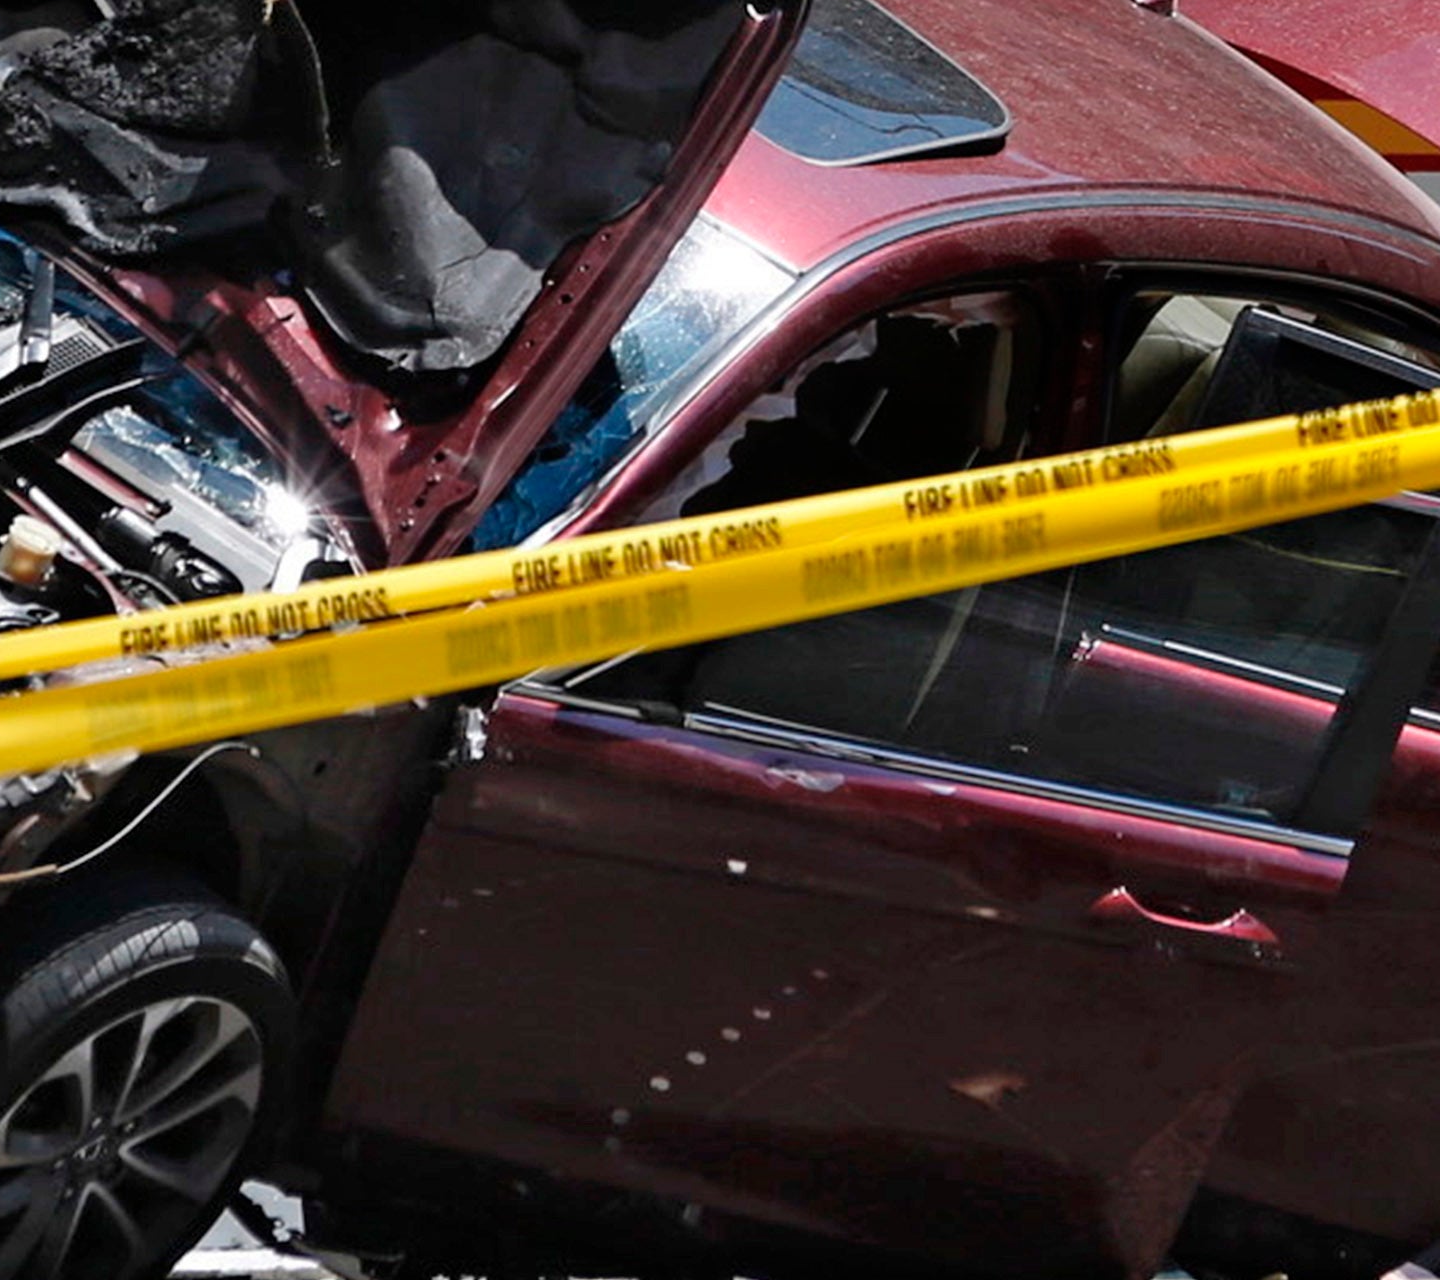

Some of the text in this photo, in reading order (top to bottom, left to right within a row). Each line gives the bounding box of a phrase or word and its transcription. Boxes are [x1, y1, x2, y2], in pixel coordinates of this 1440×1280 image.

[904, 484, 955, 520] FIRE
[960, 474, 1007, 510] LINE
[1014, 467, 1047, 499] DO
[1051, 458, 1094, 491] NOT
[511, 516, 783, 593] FIRE LINE DO NOT CROSS
[120, 623, 169, 655] FIRE
[175, 614, 223, 646] LINE
[266, 598, 310, 632] NOT
[317, 586, 390, 625] CROSS
